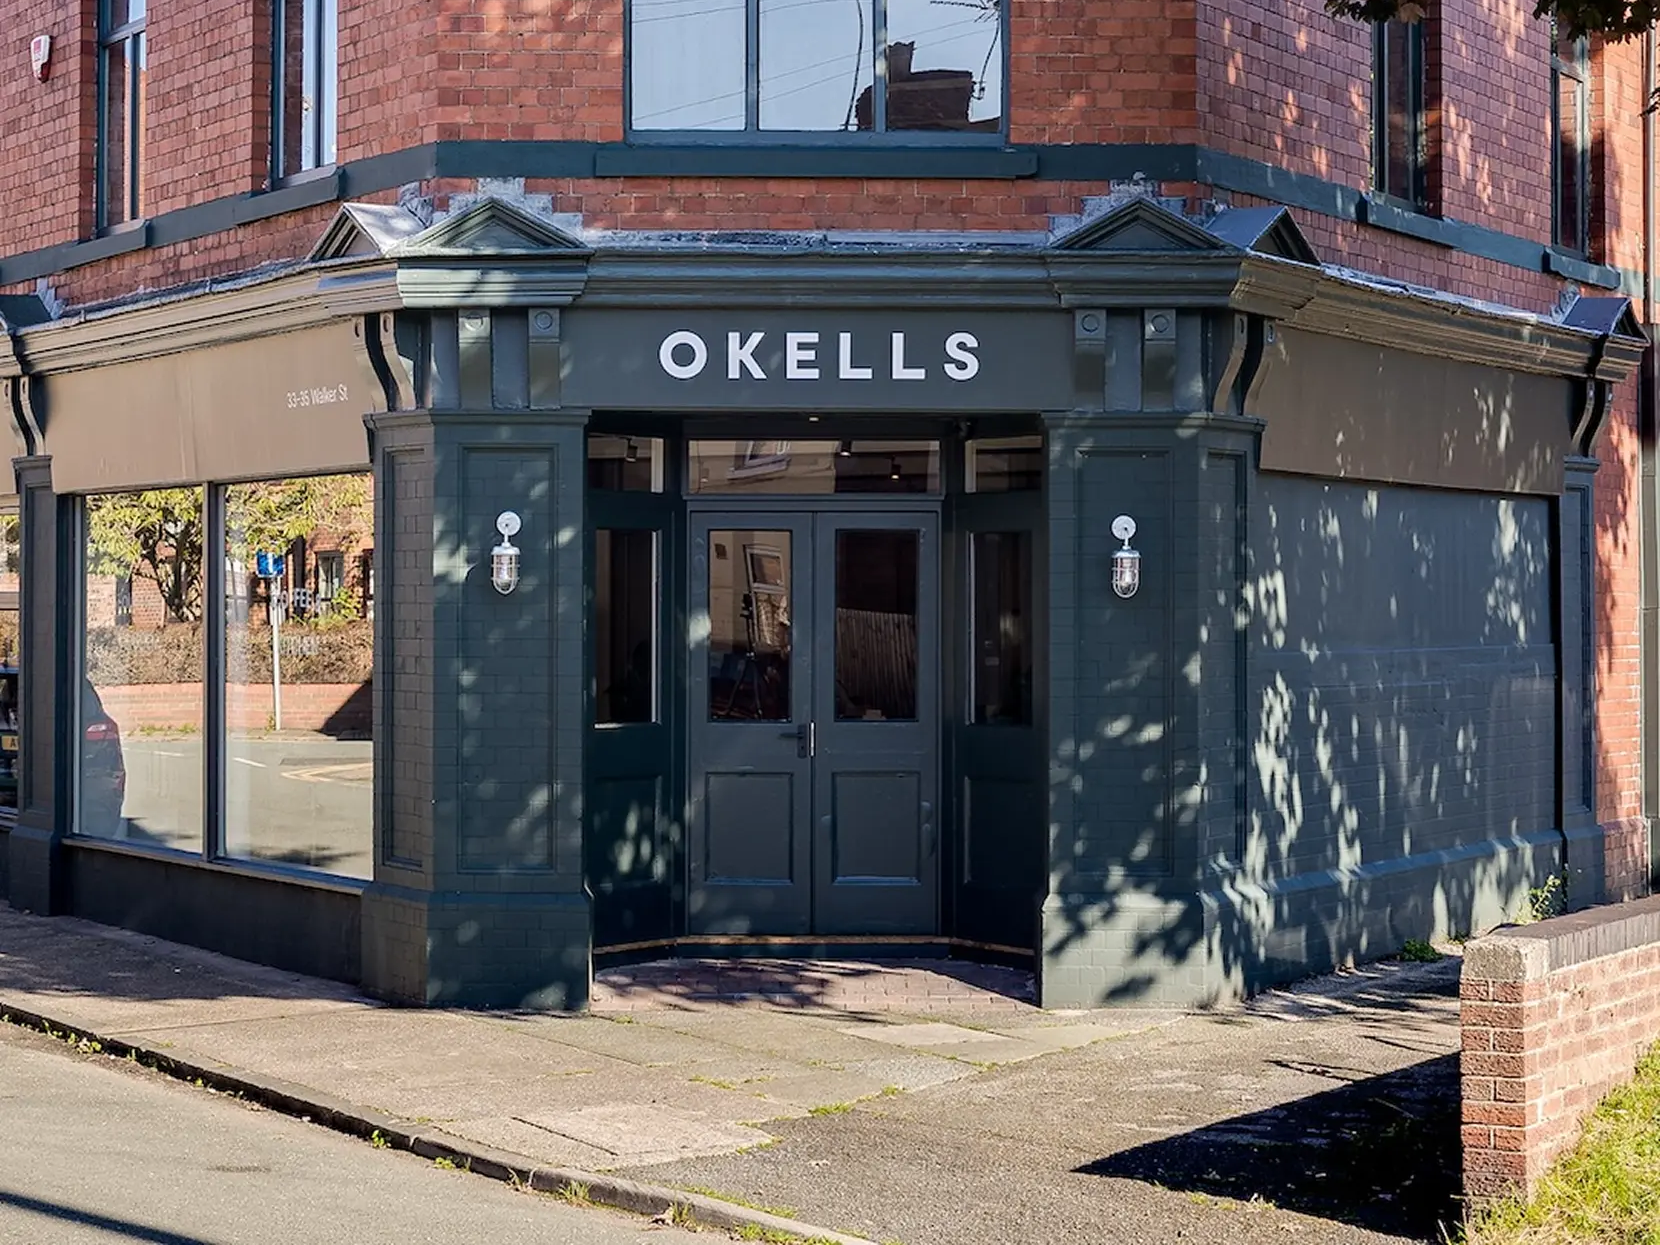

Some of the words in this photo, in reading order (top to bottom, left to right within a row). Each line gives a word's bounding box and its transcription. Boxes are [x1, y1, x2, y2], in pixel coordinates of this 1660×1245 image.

[659, 330, 981, 381] OKELLS
[286, 390, 310, 408] 33-35
[310, 386, 337, 405] Walker
[338, 383, 349, 401] St
